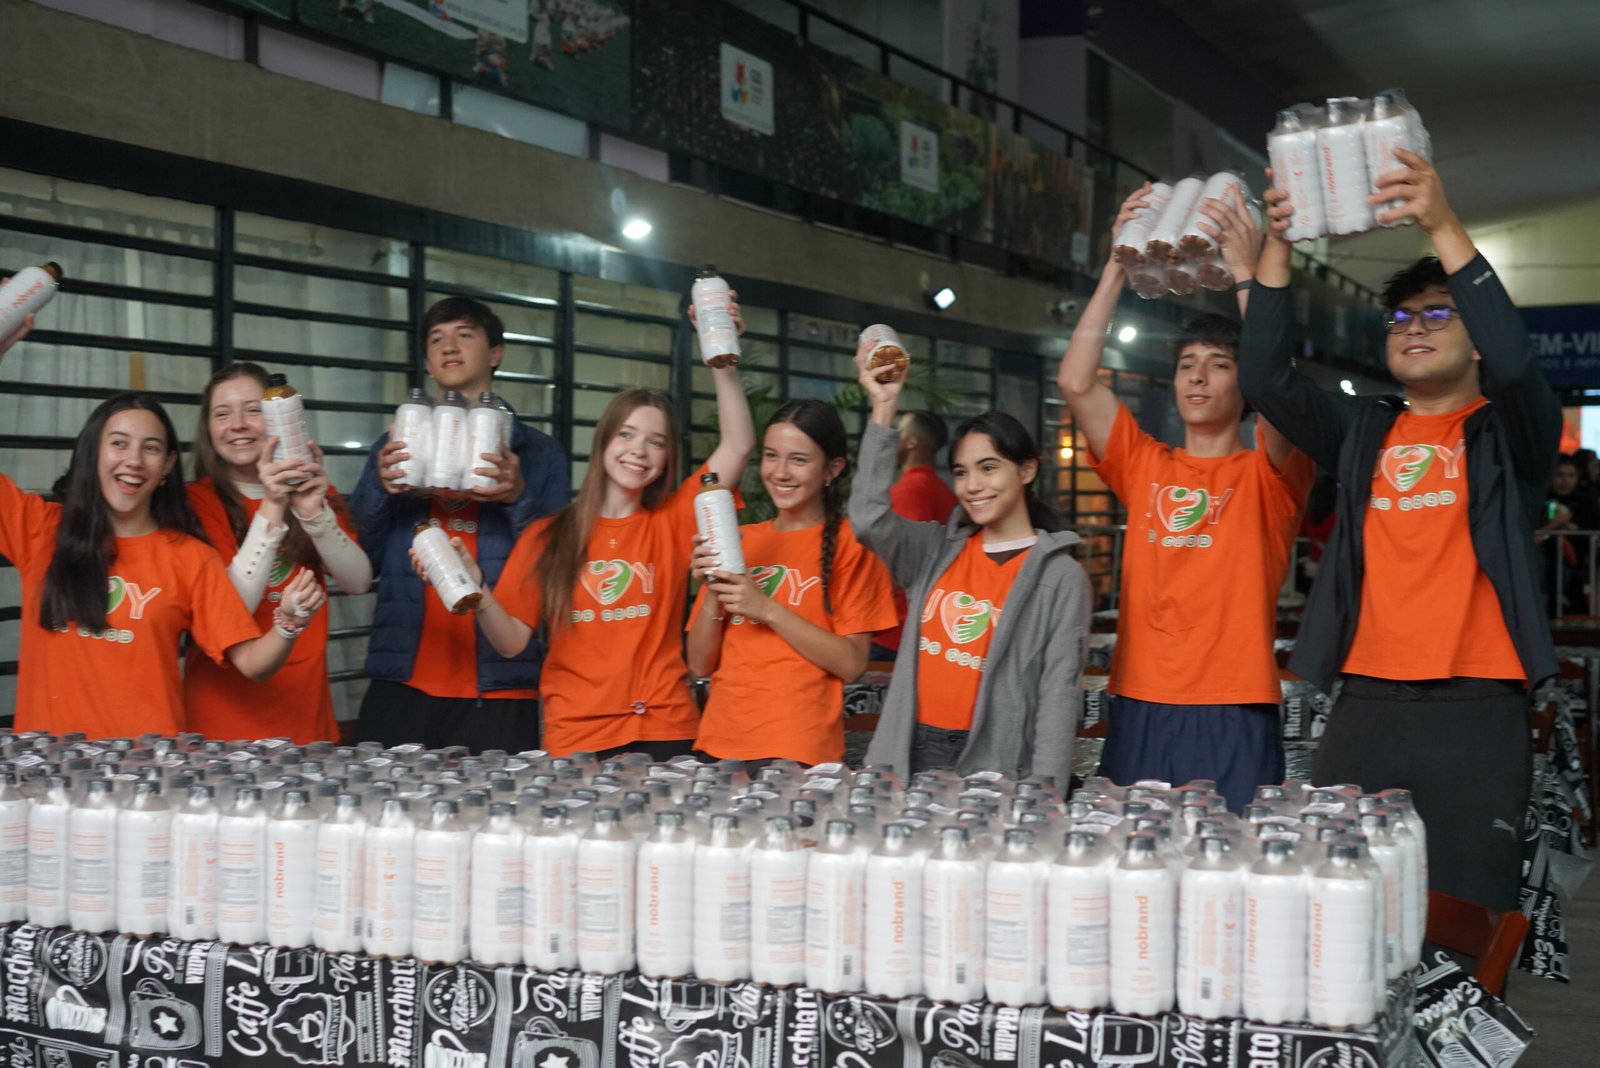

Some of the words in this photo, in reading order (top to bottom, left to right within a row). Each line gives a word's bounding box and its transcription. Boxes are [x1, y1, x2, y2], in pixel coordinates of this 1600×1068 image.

[601, 604, 651, 622] GOOD
[273, 841, 285, 898] nobrand
[648, 866, 660, 926] nobrand
[891, 880, 904, 944] nobrand
[1136, 895, 1149, 960] nobrand
[226, 981, 270, 1057] Caffe
